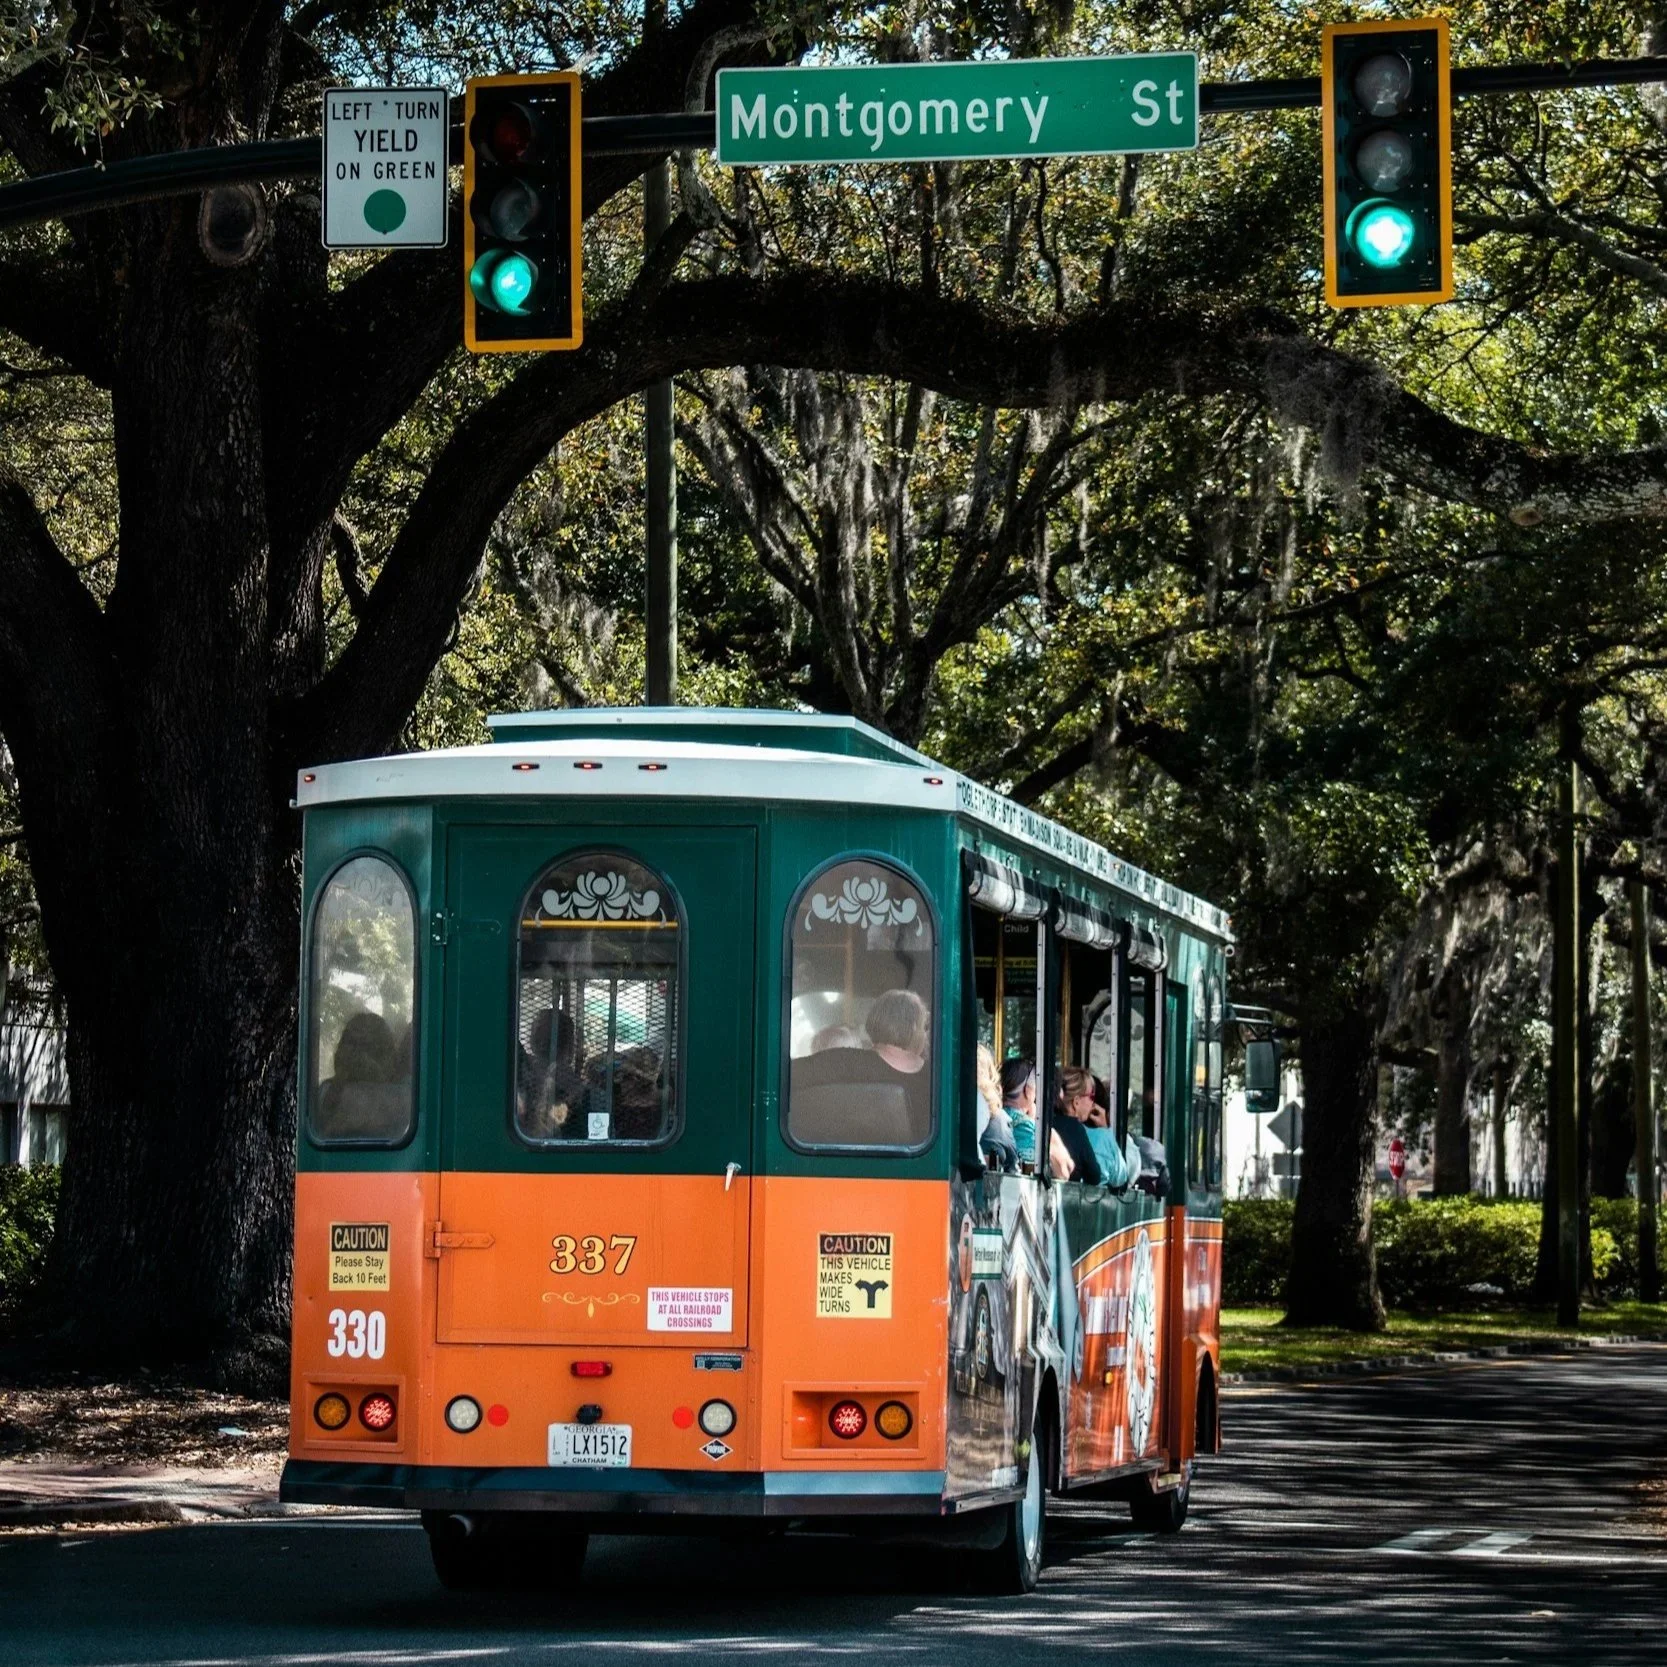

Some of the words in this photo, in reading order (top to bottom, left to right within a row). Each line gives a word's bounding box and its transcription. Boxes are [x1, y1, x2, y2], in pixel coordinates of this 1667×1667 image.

[332, 102, 372, 120] LEFT
[395, 101, 440, 119] TURN
[731, 92, 1049, 152] Montgomery
[1131, 79, 1184, 127] St
[354, 129, 418, 152] YIELD
[336, 162, 360, 180] ON
[374, 161, 435, 179] GREEN
[1004, 924, 1029, 933] Child
[334, 1228, 386, 1249] CAUTION
[824, 1237, 887, 1253] CAUTION
[549, 1234, 638, 1275] 337
[335, 1256, 363, 1268] Please
[365, 1256, 384, 1269] Stay
[820, 1257, 843, 1270] THIS
[847, 1257, 891, 1270] VEHICLE
[332, 1273, 354, 1284] Back
[356, 1273, 365, 1284] 10
[368, 1273, 386, 1284] Feet
[820, 1272, 852, 1284] MAKES
[651, 1291, 669, 1302] THIS
[671, 1291, 702, 1302] VEHICLE
[704, 1292, 729, 1303] STOPS
[819, 1286, 843, 1299] WIDE
[658, 1304, 667, 1315] AT
[669, 1304, 681, 1315] ALL
[684, 1304, 722, 1315] RAILROAD
[819, 1300, 851, 1313] TURNS
[667, 1316, 713, 1328] CROSSINGS
[327, 1308, 387, 1360] 330
[568, 1425, 613, 1434] GEORGIA
[573, 1434, 627, 1456] LX1512
